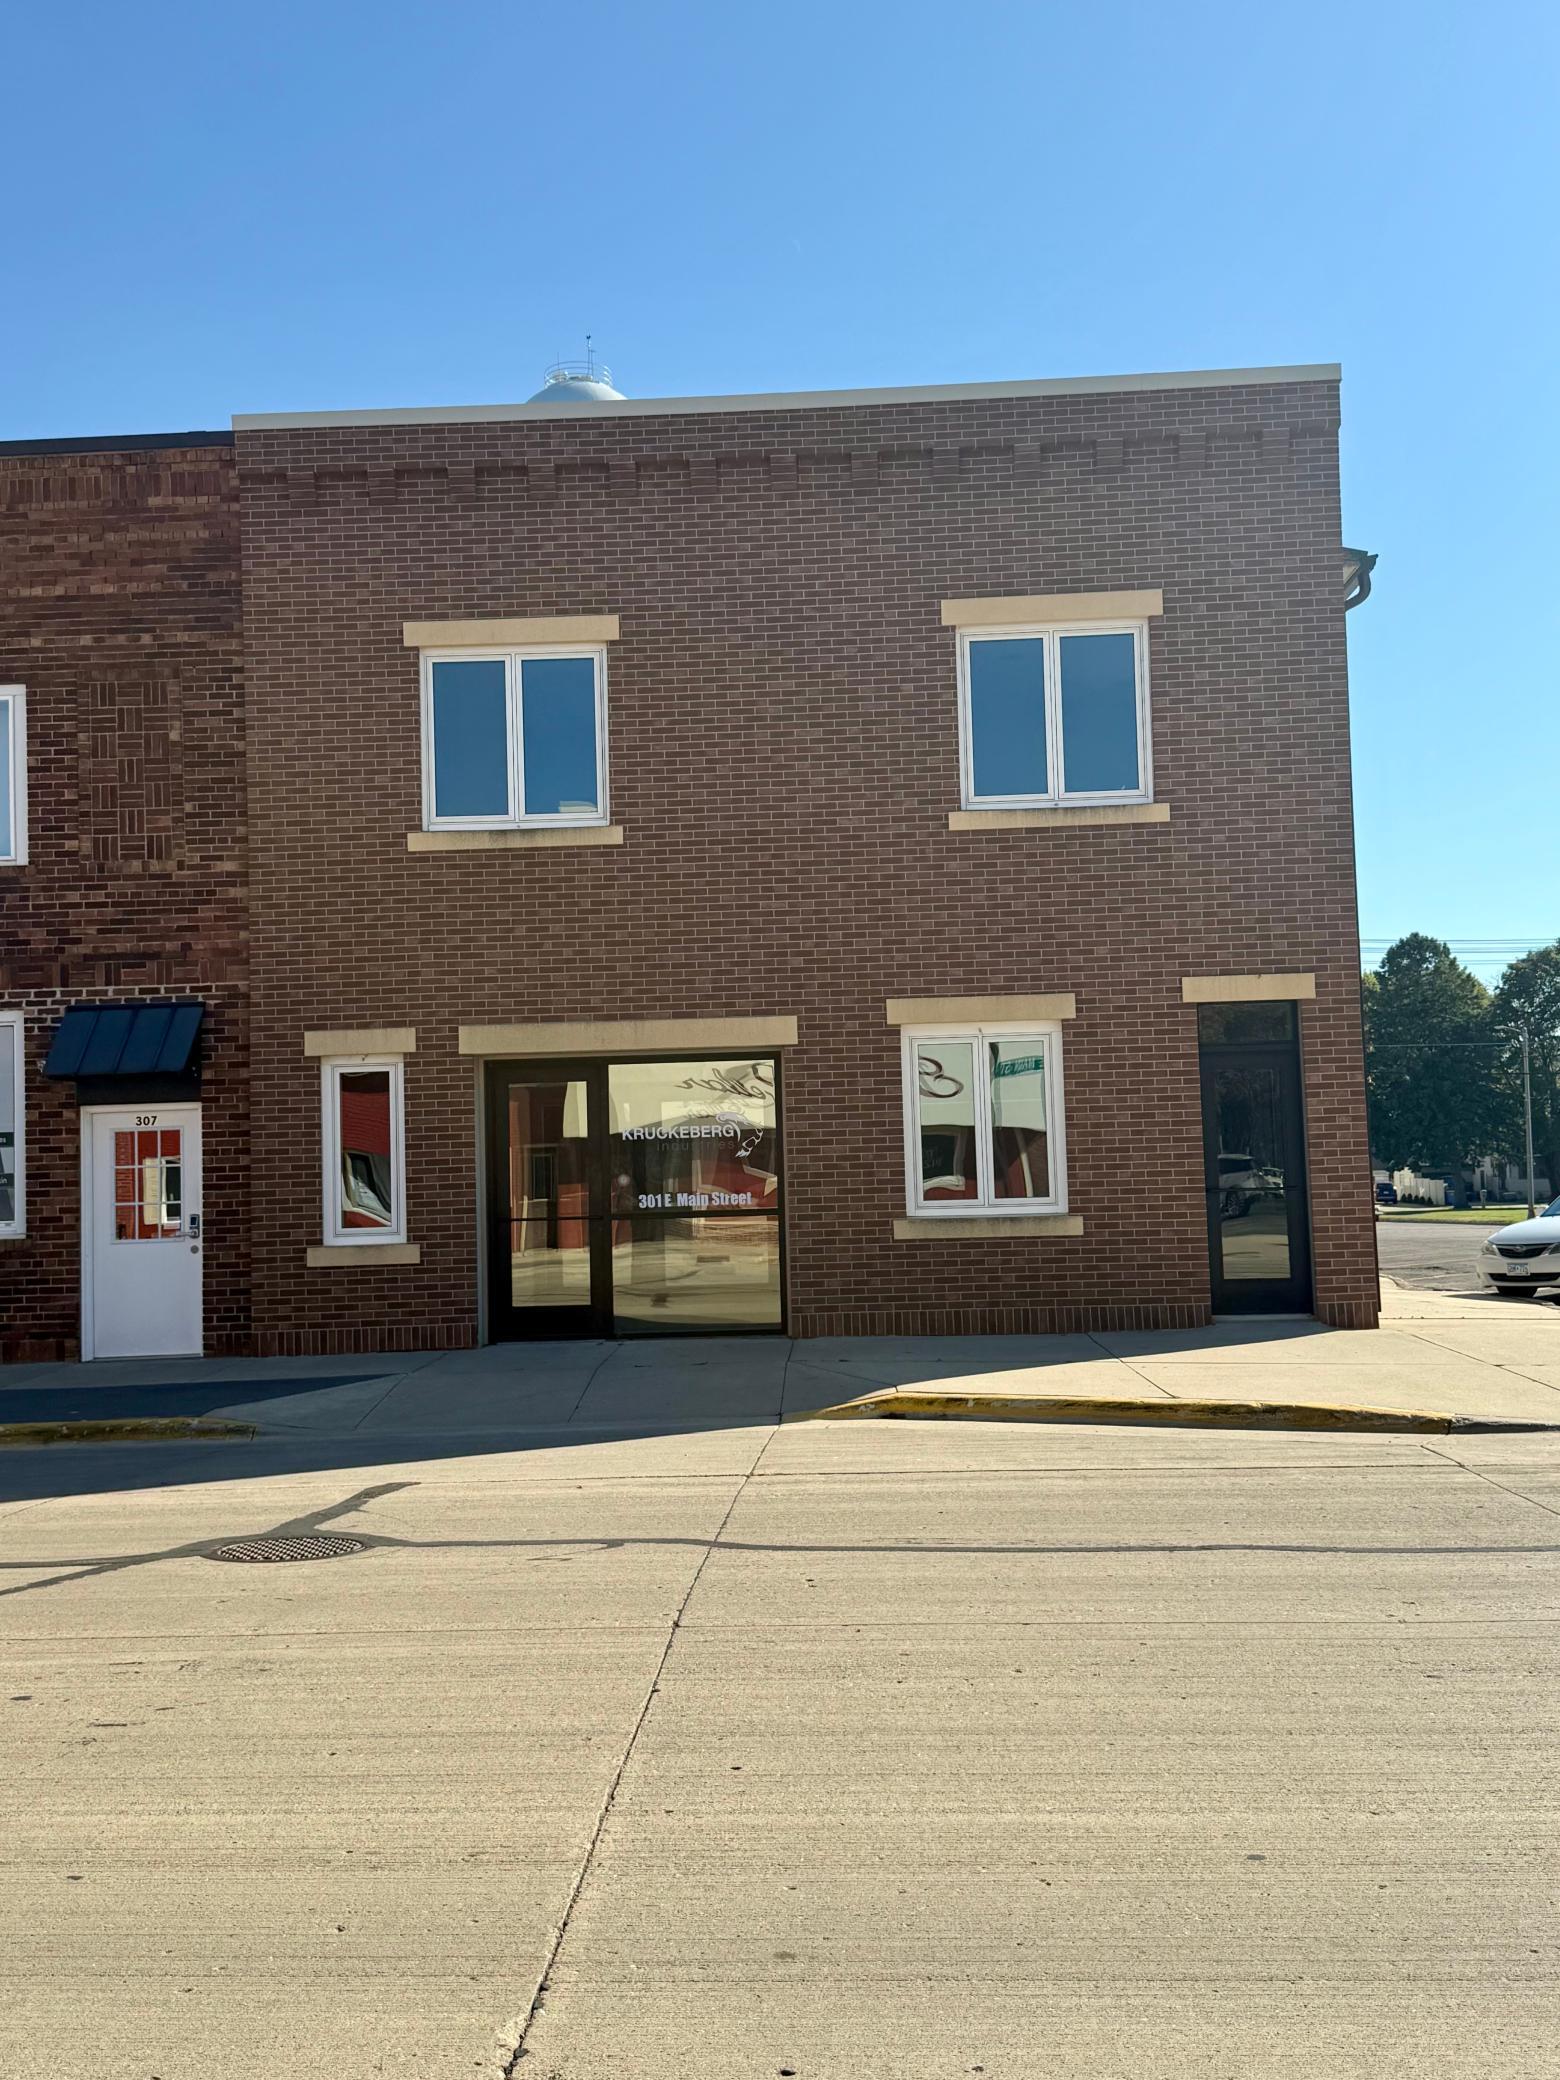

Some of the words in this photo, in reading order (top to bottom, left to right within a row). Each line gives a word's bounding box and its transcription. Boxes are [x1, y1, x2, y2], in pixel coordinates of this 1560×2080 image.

[135, 1115, 158, 1126] 307
[622, 1125, 735, 1141] KRUCKEBERG
[639, 1194, 662, 1208] 301
[664, 1193, 672, 1207] E
[676, 1193, 709, 1207] Main
[711, 1191, 752, 1206] Street
